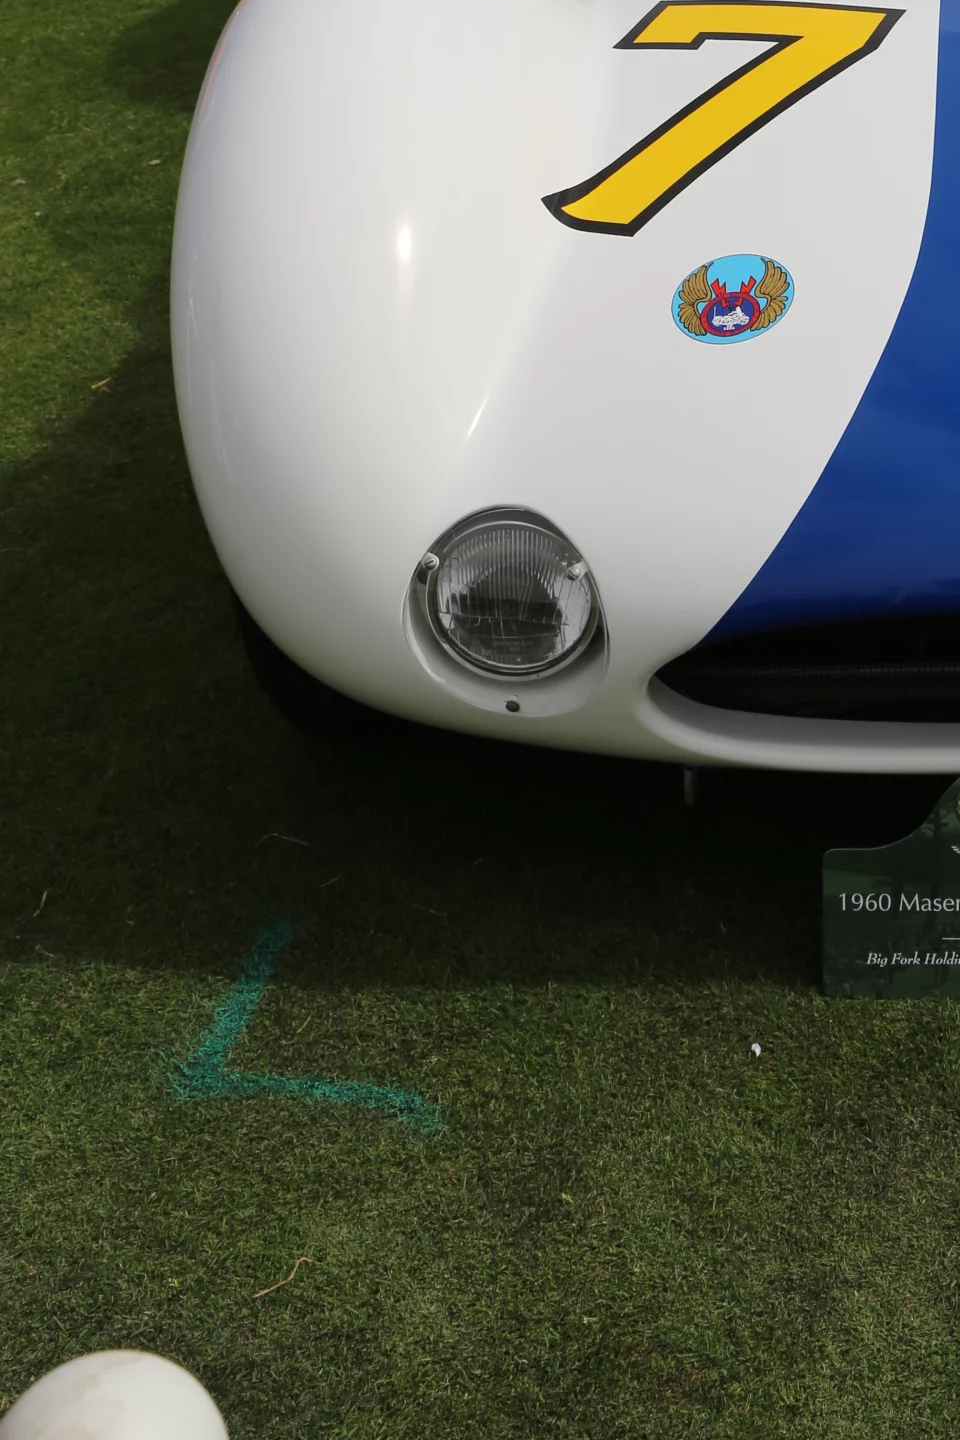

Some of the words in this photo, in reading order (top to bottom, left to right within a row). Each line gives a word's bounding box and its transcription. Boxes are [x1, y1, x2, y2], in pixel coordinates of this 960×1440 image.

[541, 0, 907, 237] 7
[838, 892, 892, 912] 1960
[866, 952, 888, 967] Big
[891, 951, 921, 965] Fork
